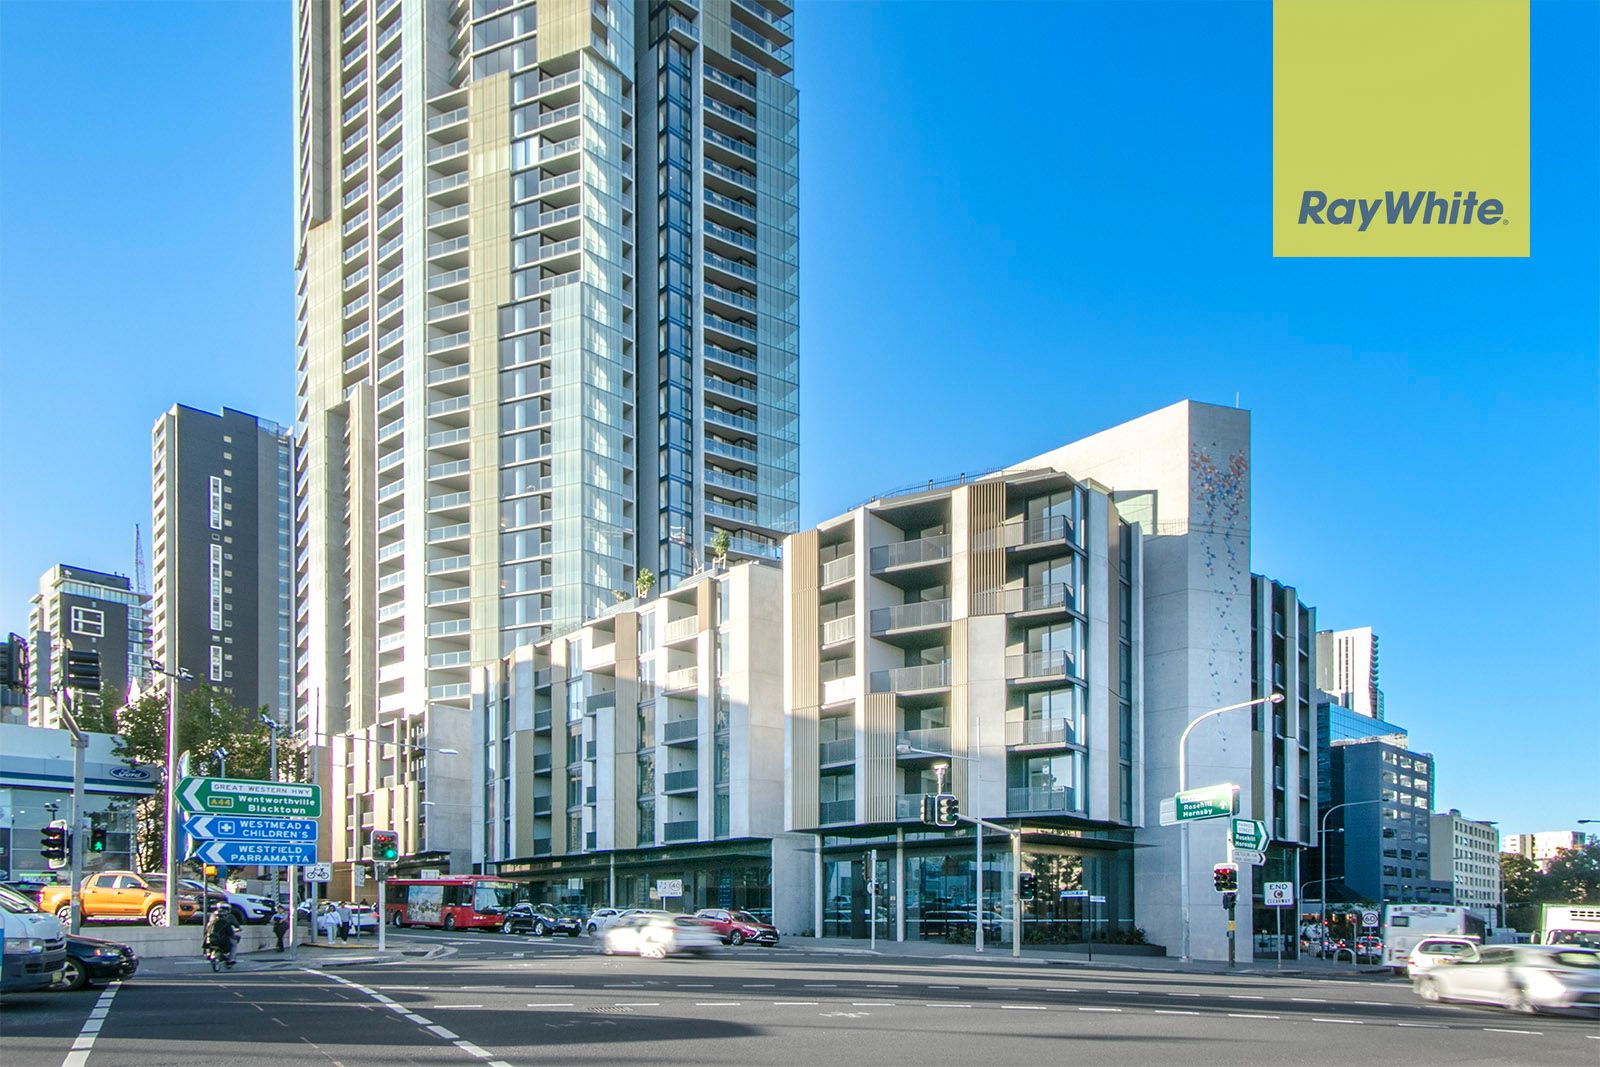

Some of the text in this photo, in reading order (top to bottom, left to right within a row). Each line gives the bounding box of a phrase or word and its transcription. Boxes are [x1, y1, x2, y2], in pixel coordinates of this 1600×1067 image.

[118, 769, 141, 777] Ford
[214, 784, 243, 792] GREAT
[248, 786, 289, 794] WESTERN
[238, 795, 315, 806] Wentworthville
[1183, 800, 1213, 810] Rosehill
[248, 804, 306, 814] Blacktown
[1183, 808, 1213, 817] Hornsby
[240, 821, 303, 830] WESTMEAD
[242, 829, 309, 839] CHILDREN'S
[239, 845, 303, 854] WESTFIELD
[231, 855, 310, 863] PARRAMATTA
